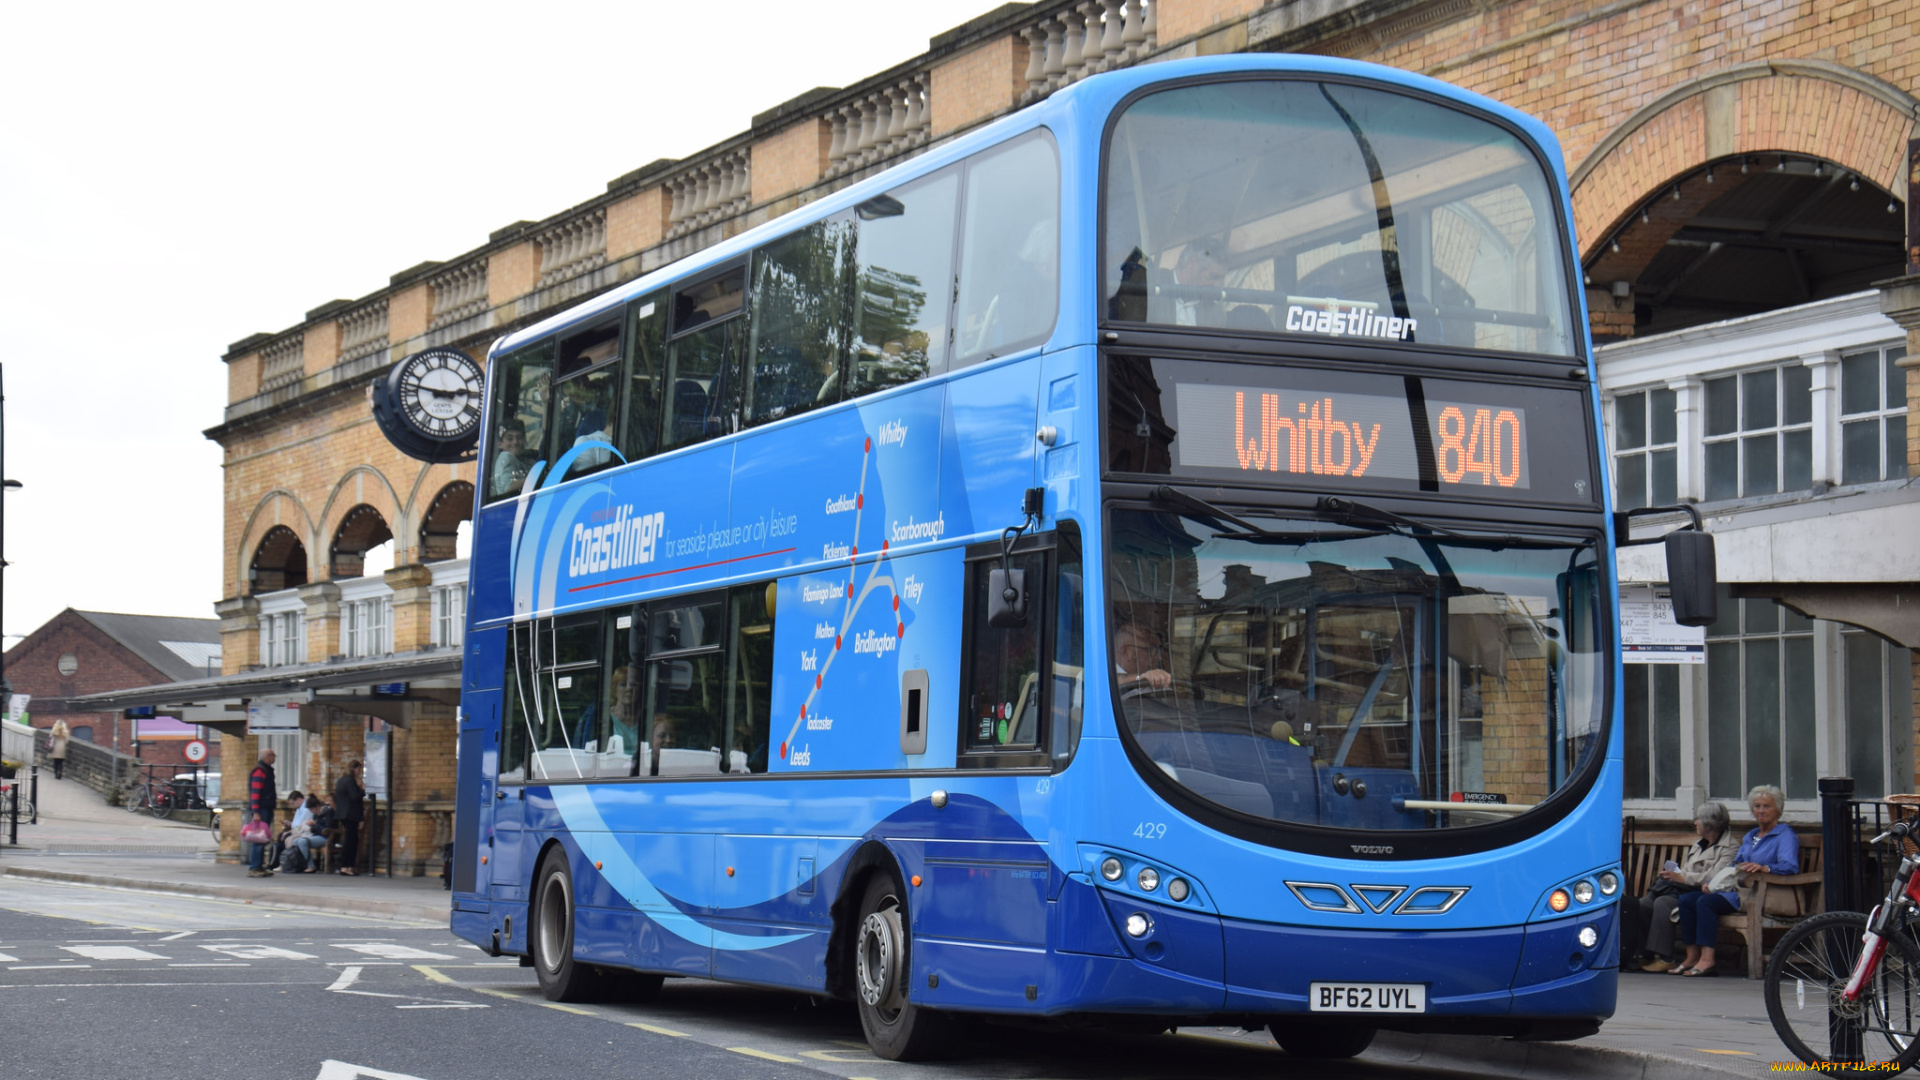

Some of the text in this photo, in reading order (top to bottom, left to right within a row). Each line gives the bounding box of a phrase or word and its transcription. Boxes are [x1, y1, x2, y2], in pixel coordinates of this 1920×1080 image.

[1286, 305, 1417, 339] Coastliner
[878, 418, 908, 448] Whitby
[1234, 391, 1520, 488] Whitby 840
[825, 491, 857, 515] Goathland
[665, 507, 797, 559] for seaside pleasure or city leisure
[891, 510, 945, 542] Scarborough
[569, 504, 665, 578] Coastliner
[823, 541, 850, 561] Pickering
[802, 579, 845, 605] Flamingo Land
[903, 574, 924, 604] Filey
[815, 621, 836, 640] Malton
[854, 629, 896, 658] Bridlington
[801, 648, 817, 671] York
[806, 713, 834, 731] Tadcaster
[192, 747, 199, 755] 5
[790, 743, 811, 766] Leeds
[1464, 793, 1498, 801] EMERGENCY
[1133, 822, 1167, 839] 429
[1350, 845, 1394, 854] VOLVO
[1320, 987, 1416, 1009] BF62 UYL
